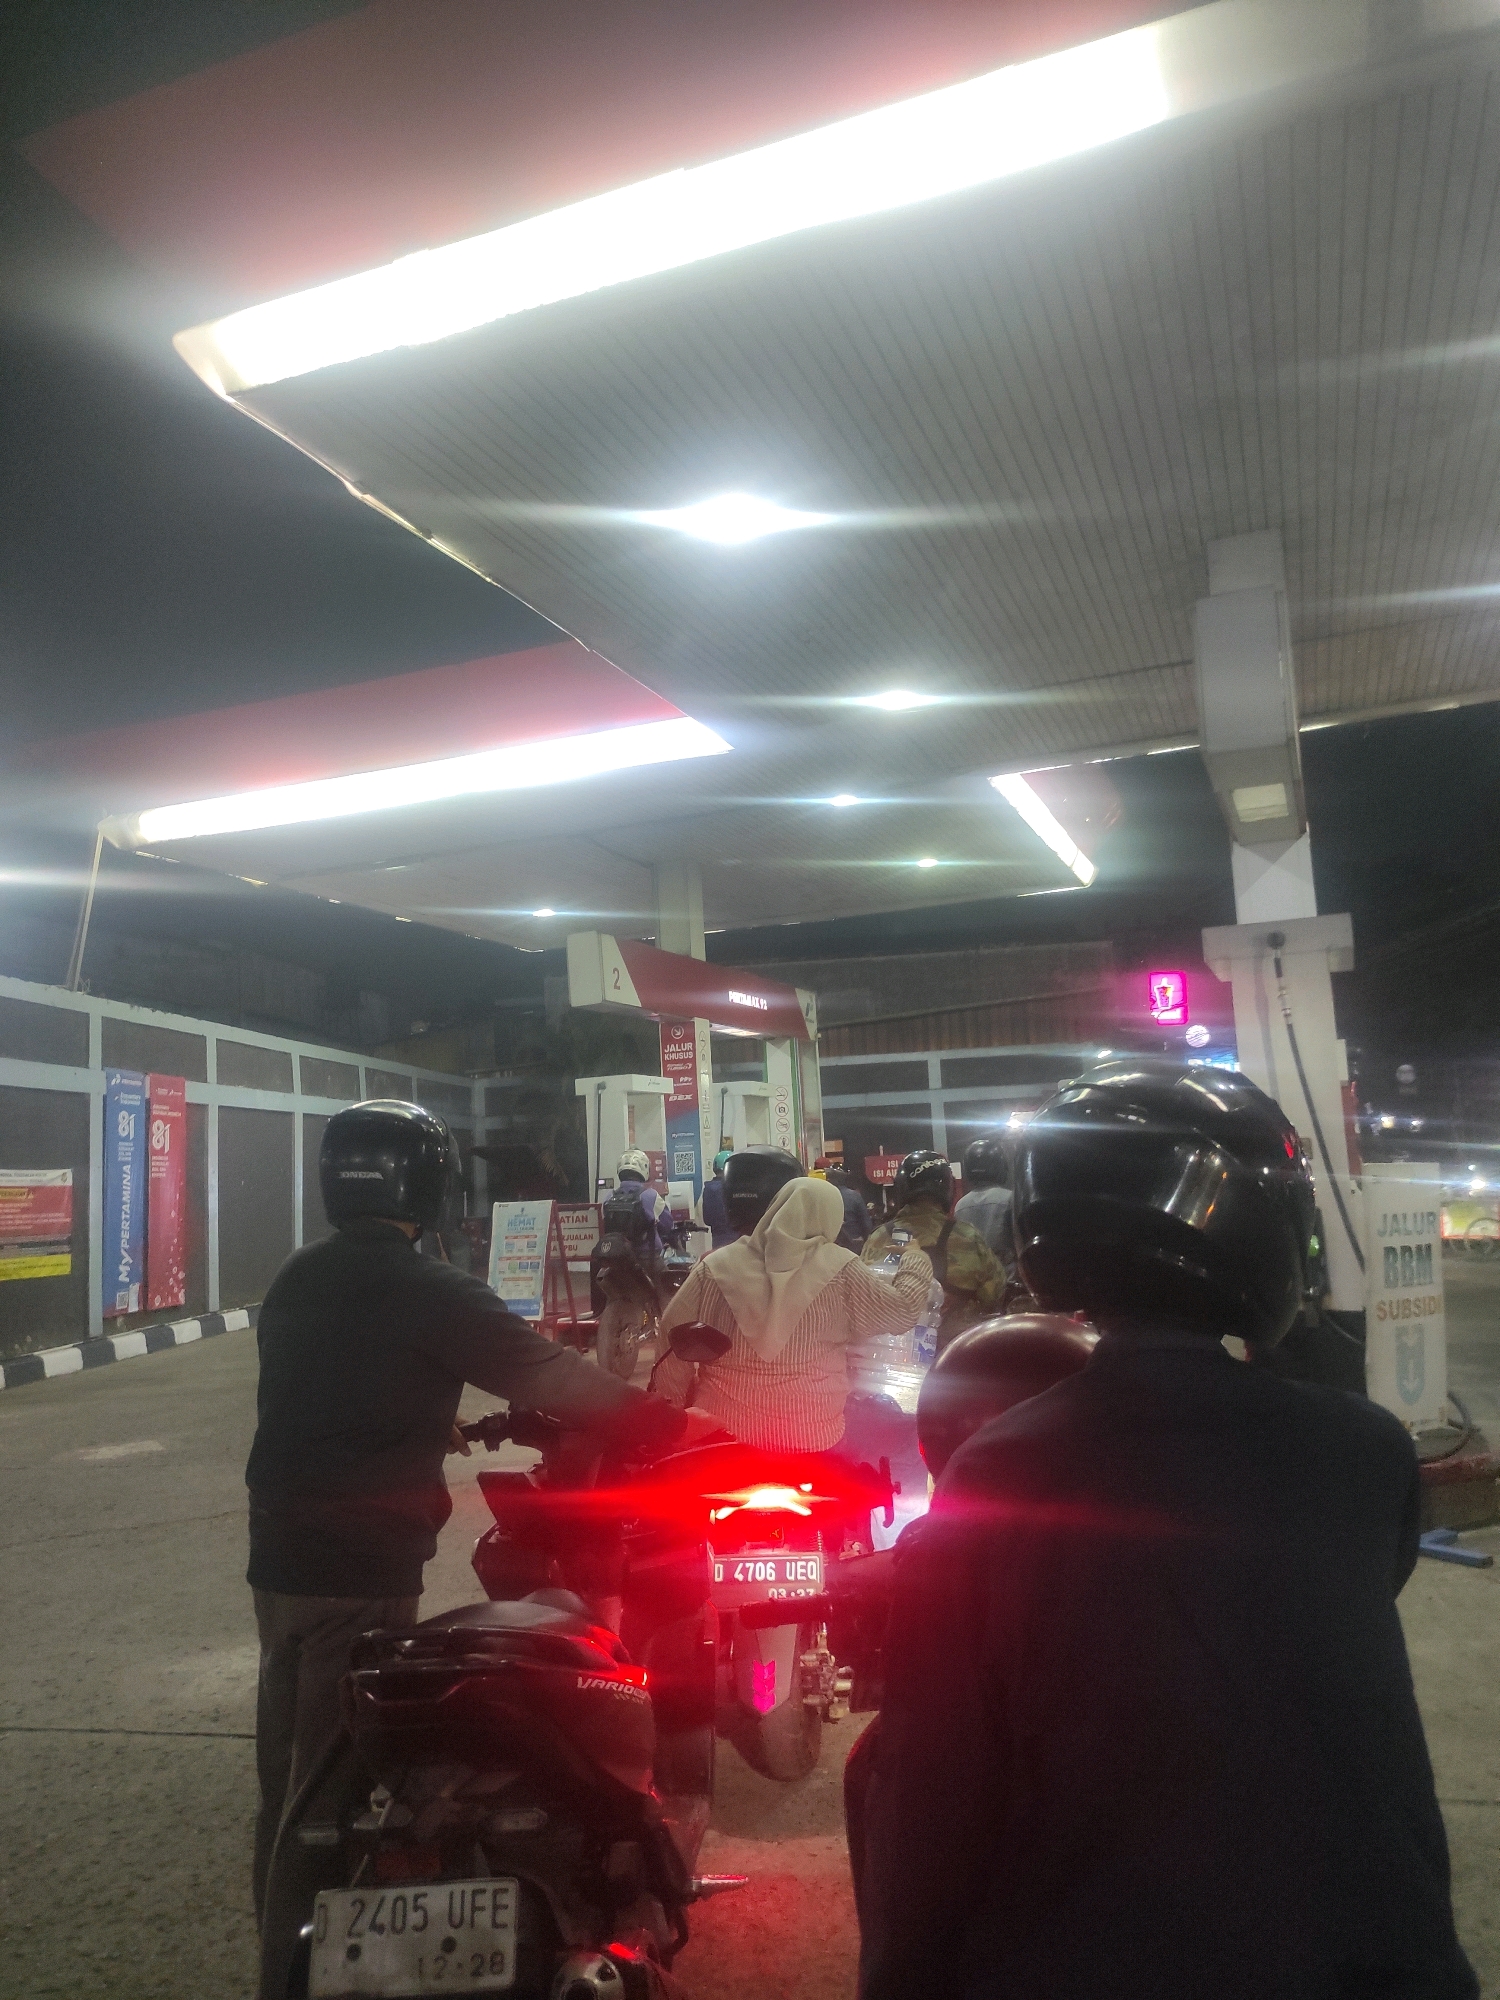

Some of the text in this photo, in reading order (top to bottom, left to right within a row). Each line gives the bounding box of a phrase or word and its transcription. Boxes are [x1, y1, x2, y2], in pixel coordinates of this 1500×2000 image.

[612, 967, 621, 990] 2
[664, 1042, 693, 1053] JALUR
[664, 1052, 694, 1061] KHUSUS
[873, 1169, 884, 1178] ISI
[559, 1214, 589, 1224] ATIAN
[1377, 1211, 1437, 1237] JALUR
[1383, 1243, 1434, 1289] BBM
[733, 1562, 776, 1582] 4706
[577, 1676, 635, 1694] VARIO
[346, 1893, 429, 1939] 2405
[447, 1887, 509, 1929] UFE
